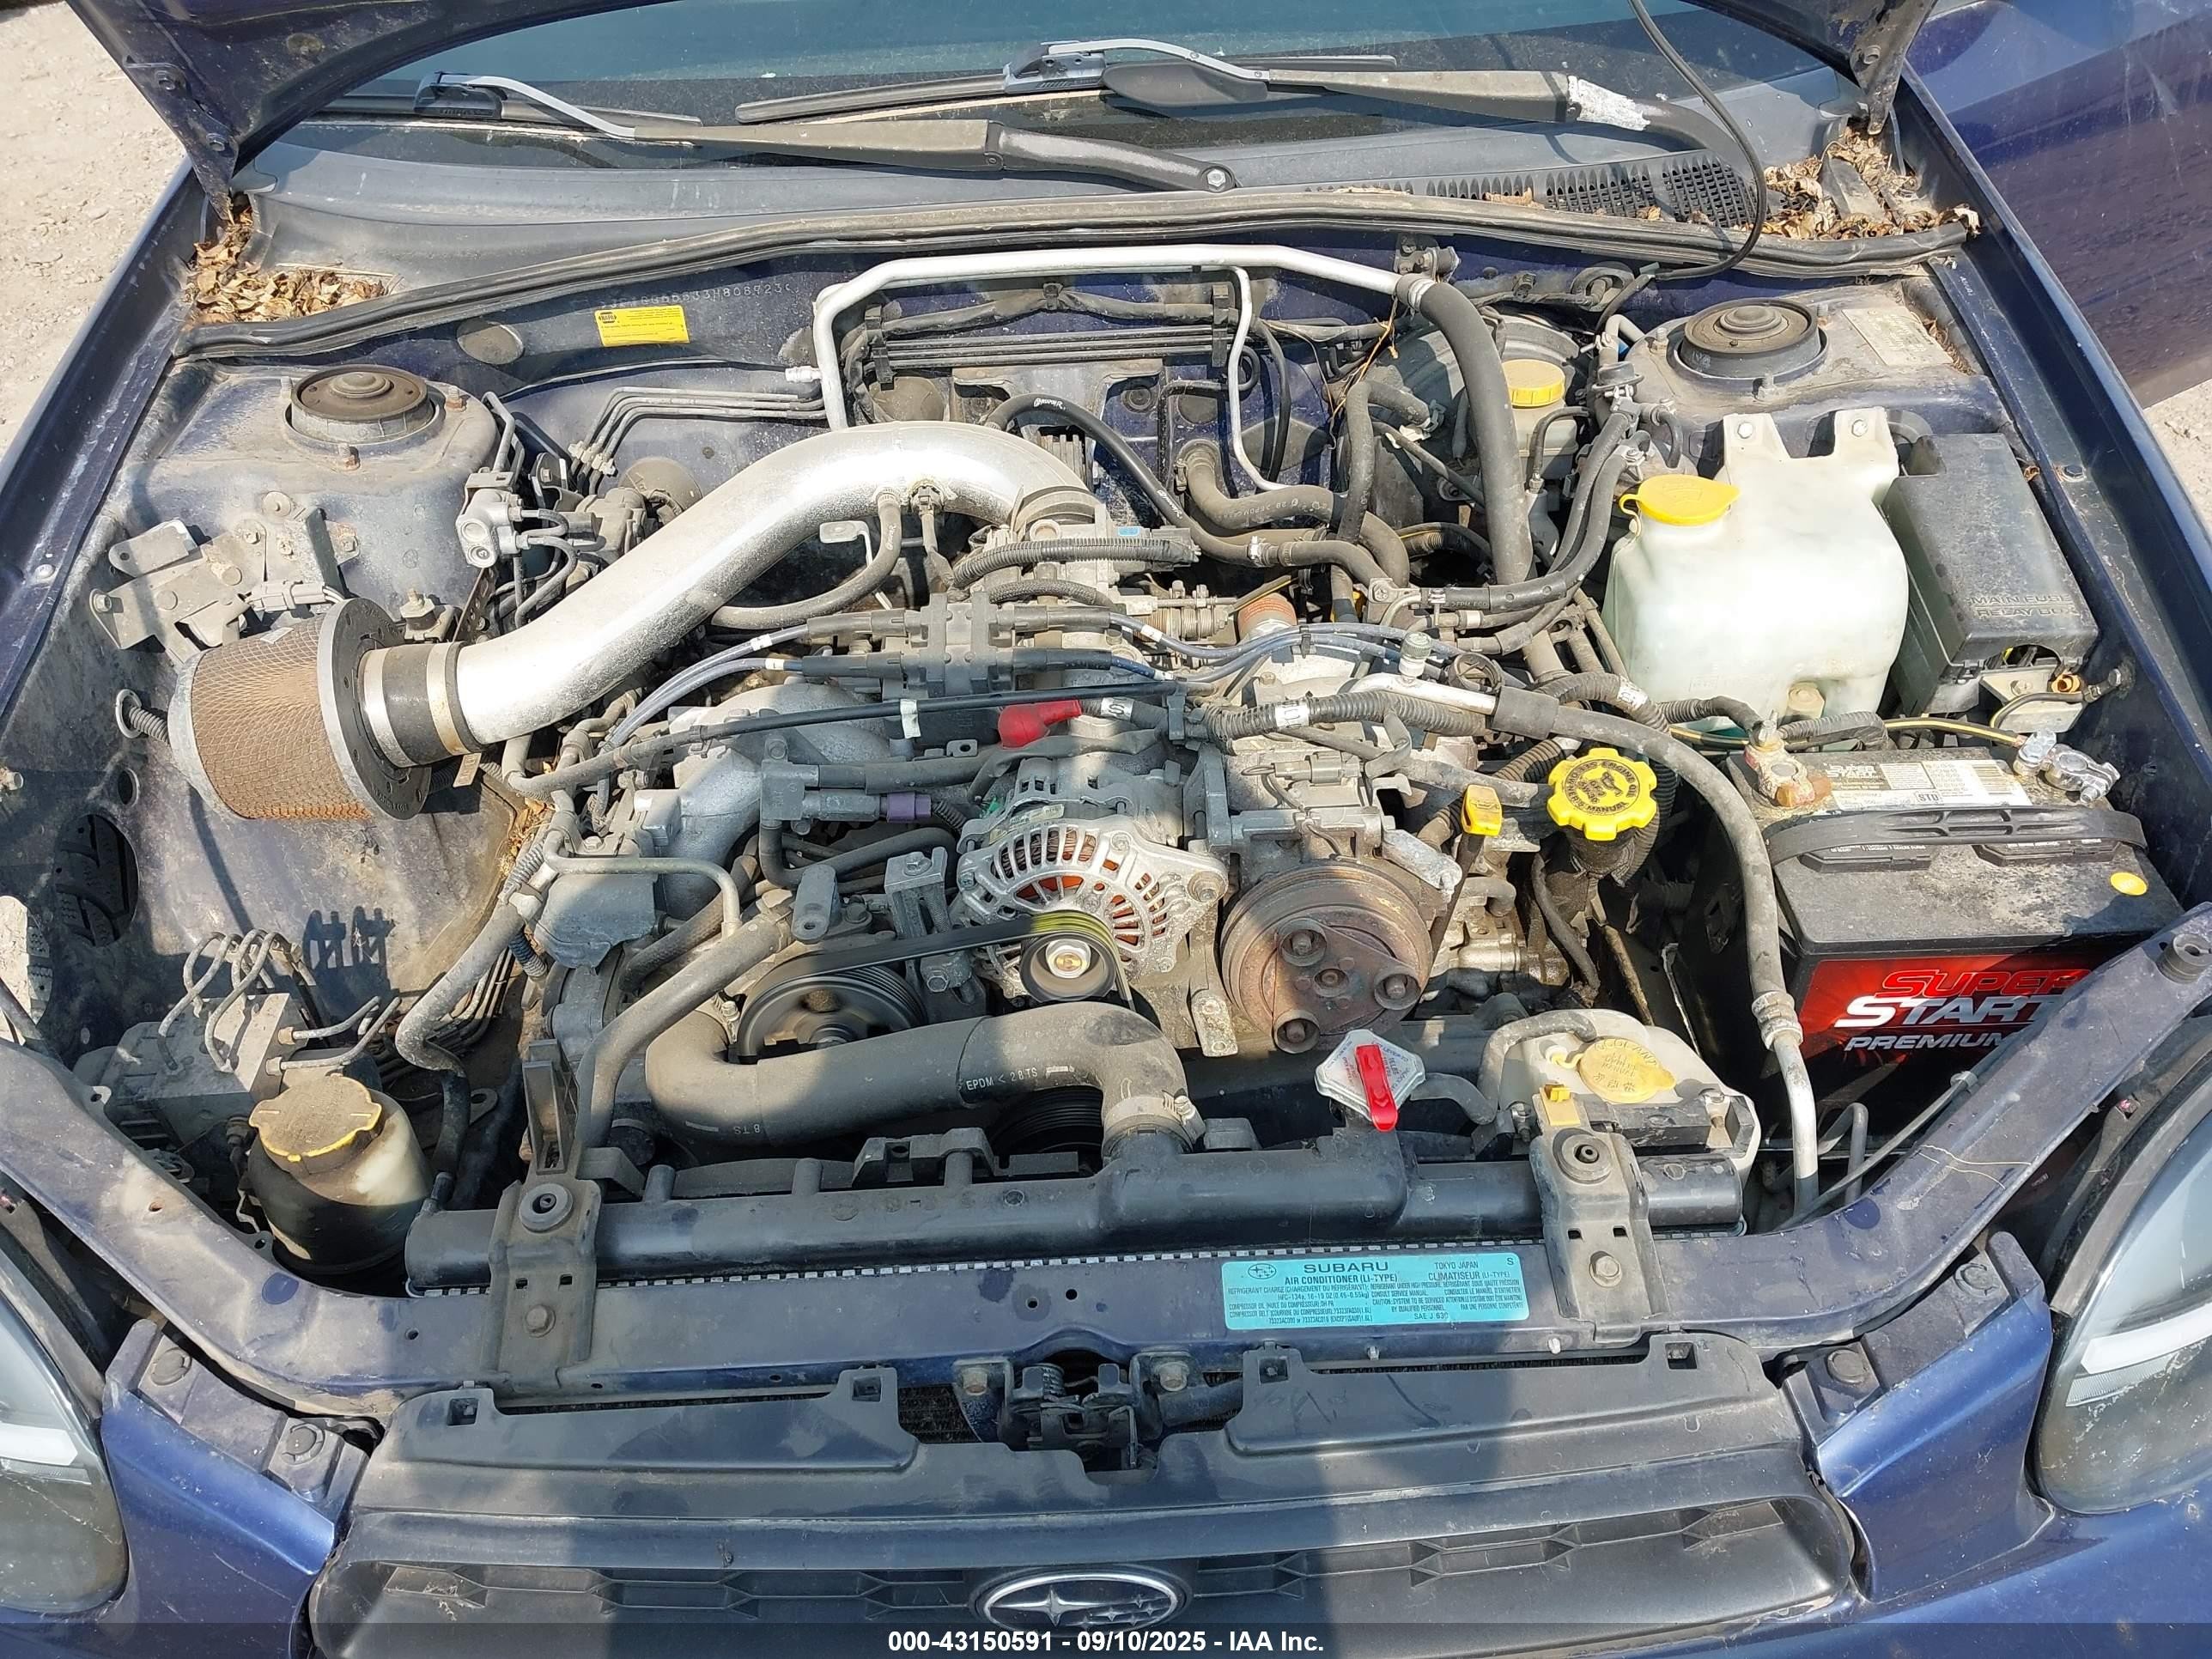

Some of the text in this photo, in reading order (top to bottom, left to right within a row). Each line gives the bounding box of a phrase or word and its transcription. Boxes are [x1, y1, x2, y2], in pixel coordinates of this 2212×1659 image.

[1971, 594, 2072, 605] MAIN FUSE
[1977, 607, 2033, 617] RELAY
[1601, 761, 1637, 798] ENGINE OIL
[1917, 793, 1939, 802] STD
[1587, 801, 1630, 812] MANUAL
[1874, 969, 2092, 999] SUPER
[1833, 995, 2062, 1028] START
[965, 1077, 994, 1091] EPDM
[1304, 1261, 1389, 1273] SUBARU
[1434, 1261, 1479, 1270] TOKYO JAPAN
[1506, 1257, 1515, 1266] S
[1285, 1273, 1398, 1285] AIR CONDITIONER (LI-TYPE)
[1428, 1271, 1481, 1280] CLIMATISEUR
